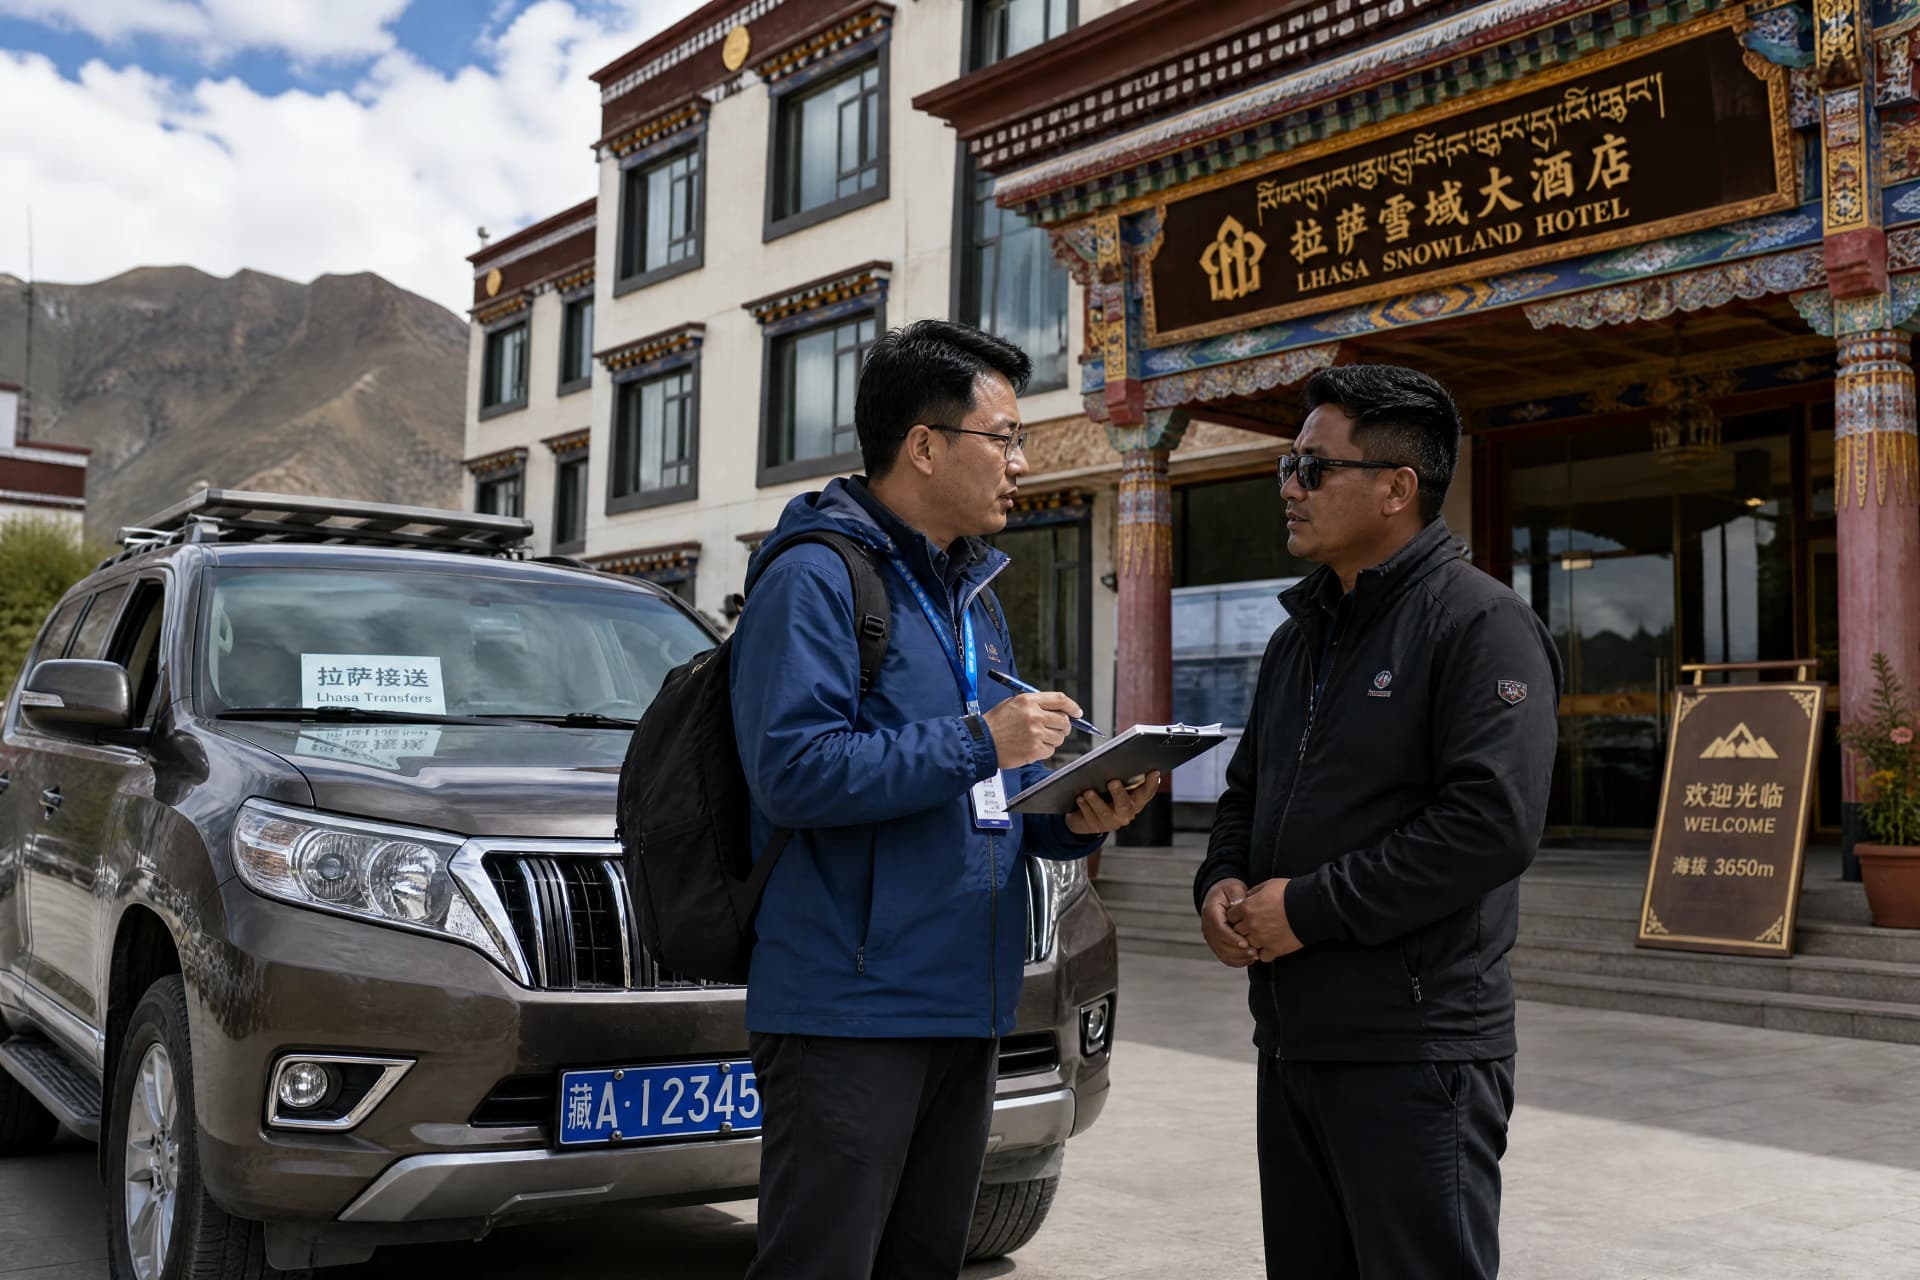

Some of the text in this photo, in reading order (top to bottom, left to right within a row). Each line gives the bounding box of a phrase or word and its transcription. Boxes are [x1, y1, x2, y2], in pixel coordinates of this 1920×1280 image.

[1291, 134, 1632, 263] 拉萨雪域大酒店
[1297, 198, 1630, 292] LHASA SNOWLAND HOTEL
[317, 666, 429, 688] 拉萨接送
[316, 692, 432, 704] Lhasa Transfers
[1683, 782, 1785, 809] 欢迎光临
[1684, 816, 1776, 834] WELCOME
[1672, 856, 1775, 878] 海拔 3650m
